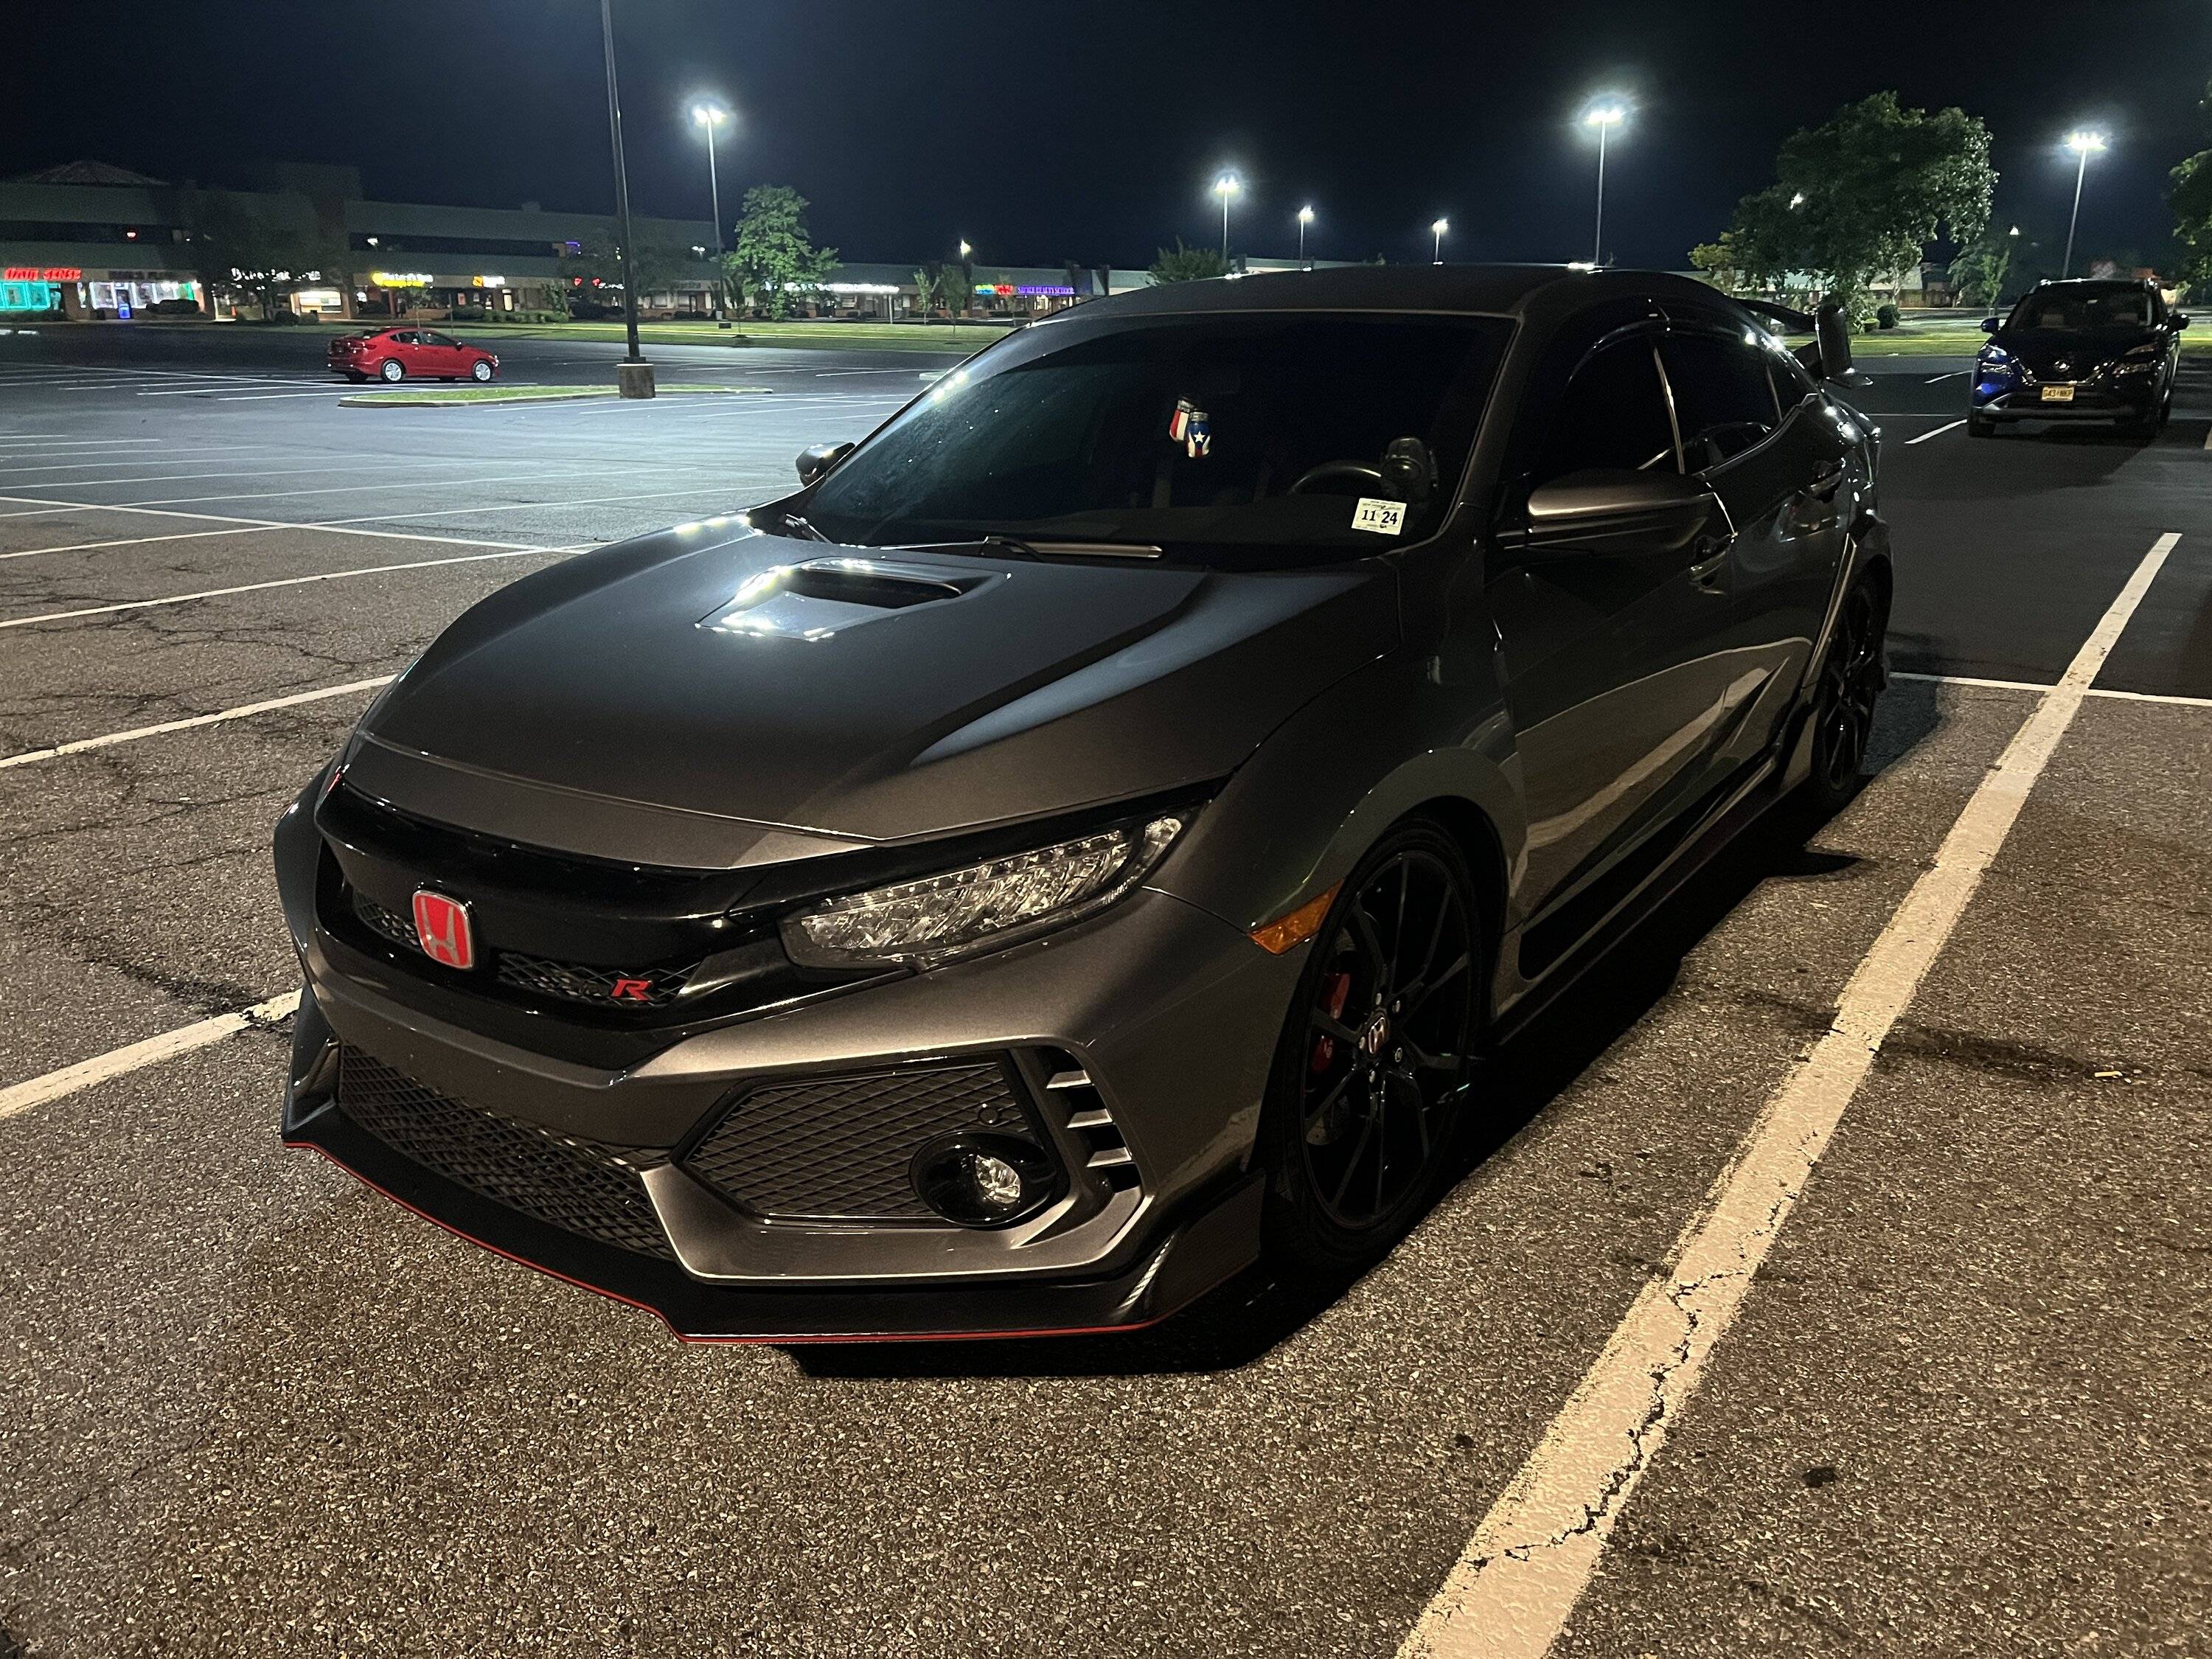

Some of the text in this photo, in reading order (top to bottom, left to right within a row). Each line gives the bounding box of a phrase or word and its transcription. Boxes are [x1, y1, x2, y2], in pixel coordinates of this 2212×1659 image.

[1361, 509, 1398, 525] 11 24
[611, 978, 649, 1001] R
